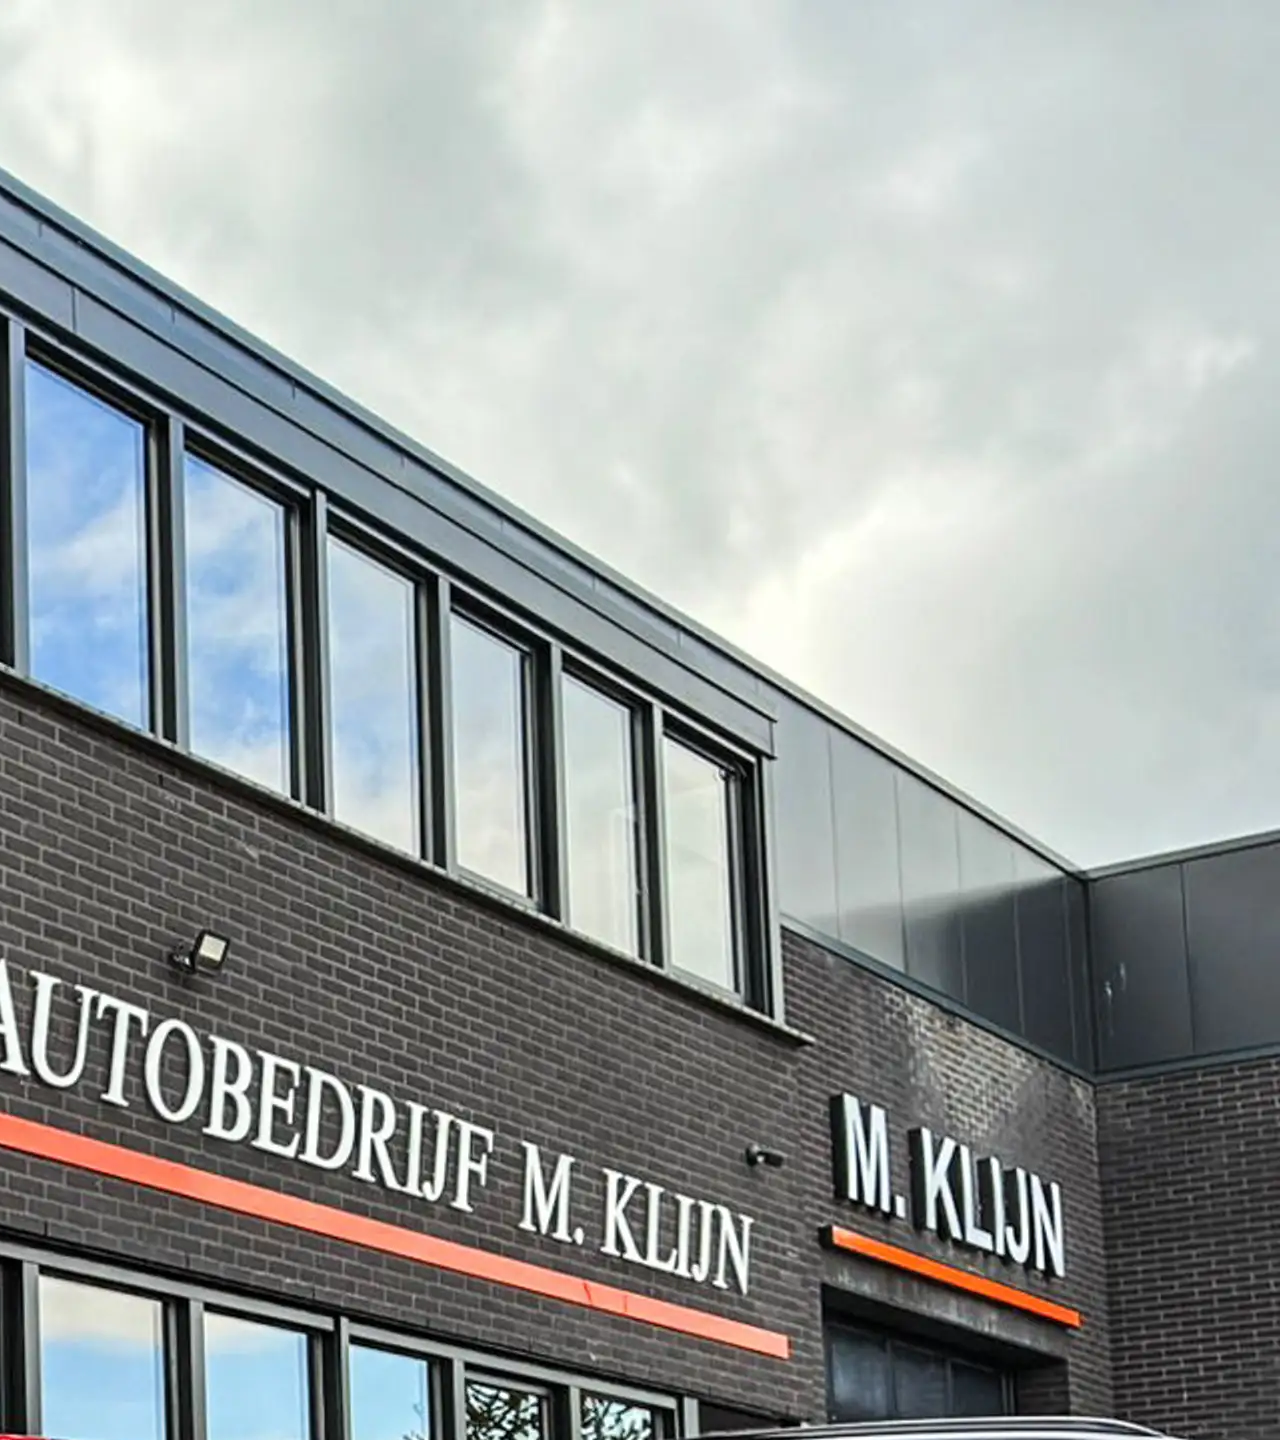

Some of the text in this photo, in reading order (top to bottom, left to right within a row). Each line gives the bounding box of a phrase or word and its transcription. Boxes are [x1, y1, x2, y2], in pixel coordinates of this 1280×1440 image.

[520, 1141, 586, 1245] M.
[602, 1167, 754, 1295] KLIJN
[840, 1093, 1066, 1278] M. KLIJN
